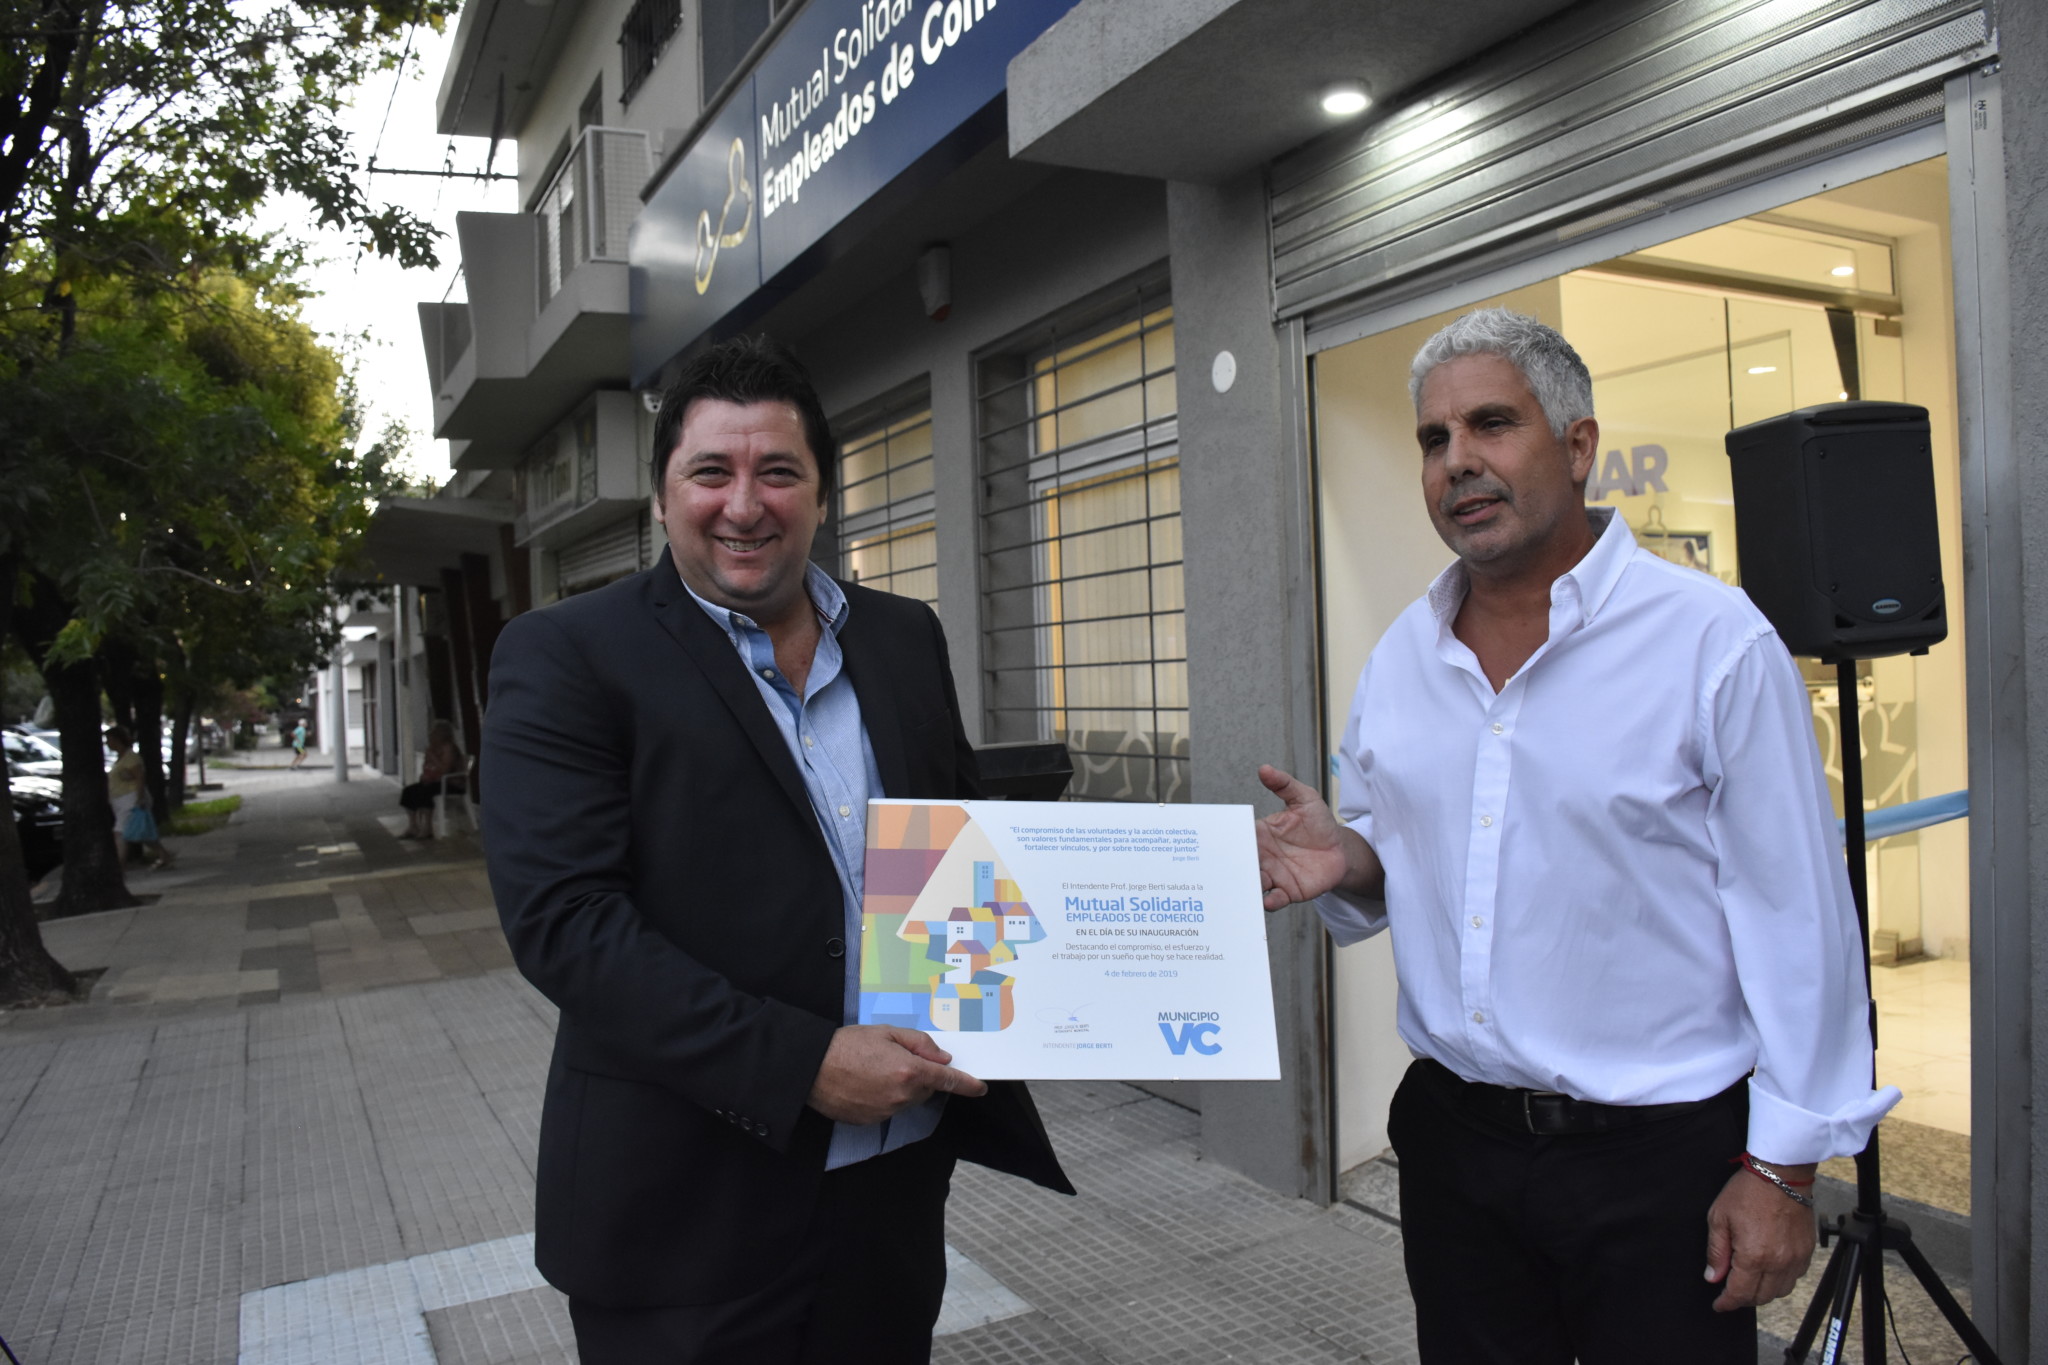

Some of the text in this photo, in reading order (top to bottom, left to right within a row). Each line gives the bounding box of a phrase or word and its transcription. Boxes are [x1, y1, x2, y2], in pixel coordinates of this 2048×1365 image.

[761, 47, 829, 161] Mutual
[763, 79, 876, 219] Empleados
[881, 41, 915, 105] de
[1021, 827, 1064, 836] compromiso
[1128, 829, 1133, 837] y
[1142, 828, 1164, 836] acción
[1165, 828, 1198, 837] colectiva,
[1031, 835, 1058, 843] valores
[1059, 835, 1113, 844] fundamentales
[1114, 837, 1130, 845] para
[1131, 836, 1172, 845] acompañar,
[1173, 836, 1199, 846] ayudar,
[1024, 844, 1059, 852] fortalecer
[1060, 844, 1092, 853] vínculos,
[1062, 882, 1069, 890] El
[1070, 882, 1110, 890] Intendente
[1110, 882, 1128, 890] Prof.
[1128, 883, 1148, 892] Jorge
[1148, 883, 1166, 891] Berti
[1167, 883, 1191, 891] saluda
[1065, 896, 1204, 912] Mutual Solidaria
[1066, 912, 1205, 923] EMPLEADOS DE COMERCIO
[1100, 928, 1114, 937] DÍA
[1115, 929, 1126, 937] DE
[1127, 929, 1138, 937] SU
[1139, 928, 1199, 937] INAUGURACIÓN
[1065, 943, 1109, 951] Destacando
[1110, 943, 1117, 951] el
[1118, 944, 1163, 953] compromiso,
[1172, 943, 1204, 951] esfuerzo
[1206, 945, 1211, 953] y
[1060, 953, 1086, 962] trabajo
[1087, 954, 1100, 962] por
[1112, 953, 1135, 961] sueño
[1136, 954, 1150, 962] que
[1150, 953, 1165, 962] hoy
[1176, 953, 1194, 961] hace
[1194, 953, 1225, 961] realidad.
[1121, 970, 1148, 978] febrero
[1148, 970, 1158, 978] de
[1158, 970, 1179, 978] 2019
[1158, 1011, 1220, 1022] MUNICIPIO
[1158, 1022, 1223, 1056] VC
[1076, 1042, 1095, 1050] JORGE
[1822, 1317, 1842, 1365] SAMS
